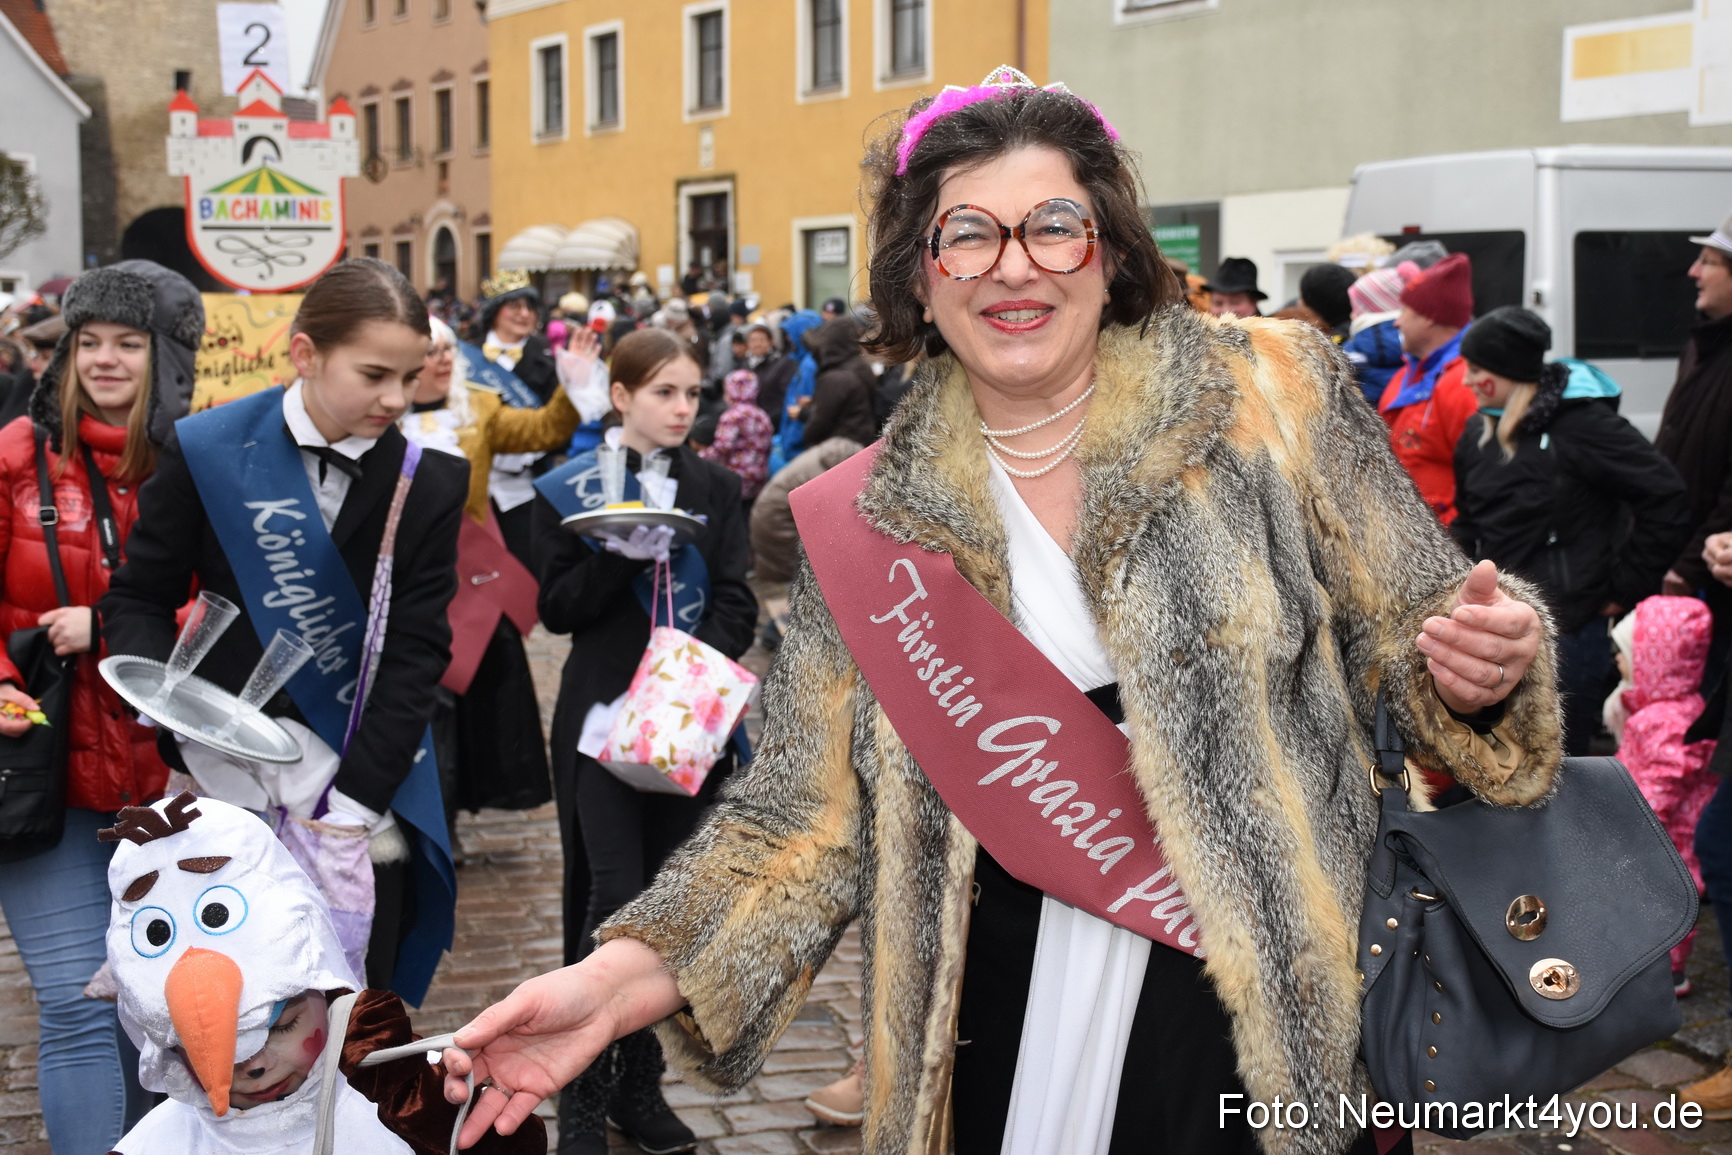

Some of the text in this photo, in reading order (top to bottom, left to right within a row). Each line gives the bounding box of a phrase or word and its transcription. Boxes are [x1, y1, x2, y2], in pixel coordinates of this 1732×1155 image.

[243, 22, 271, 67] 2
[199, 197, 333, 223] BACHAMINIS
[243, 497, 357, 677] Königlicher
[869, 557, 985, 728] Fürstin
[976, 714, 1136, 876] Grazia
